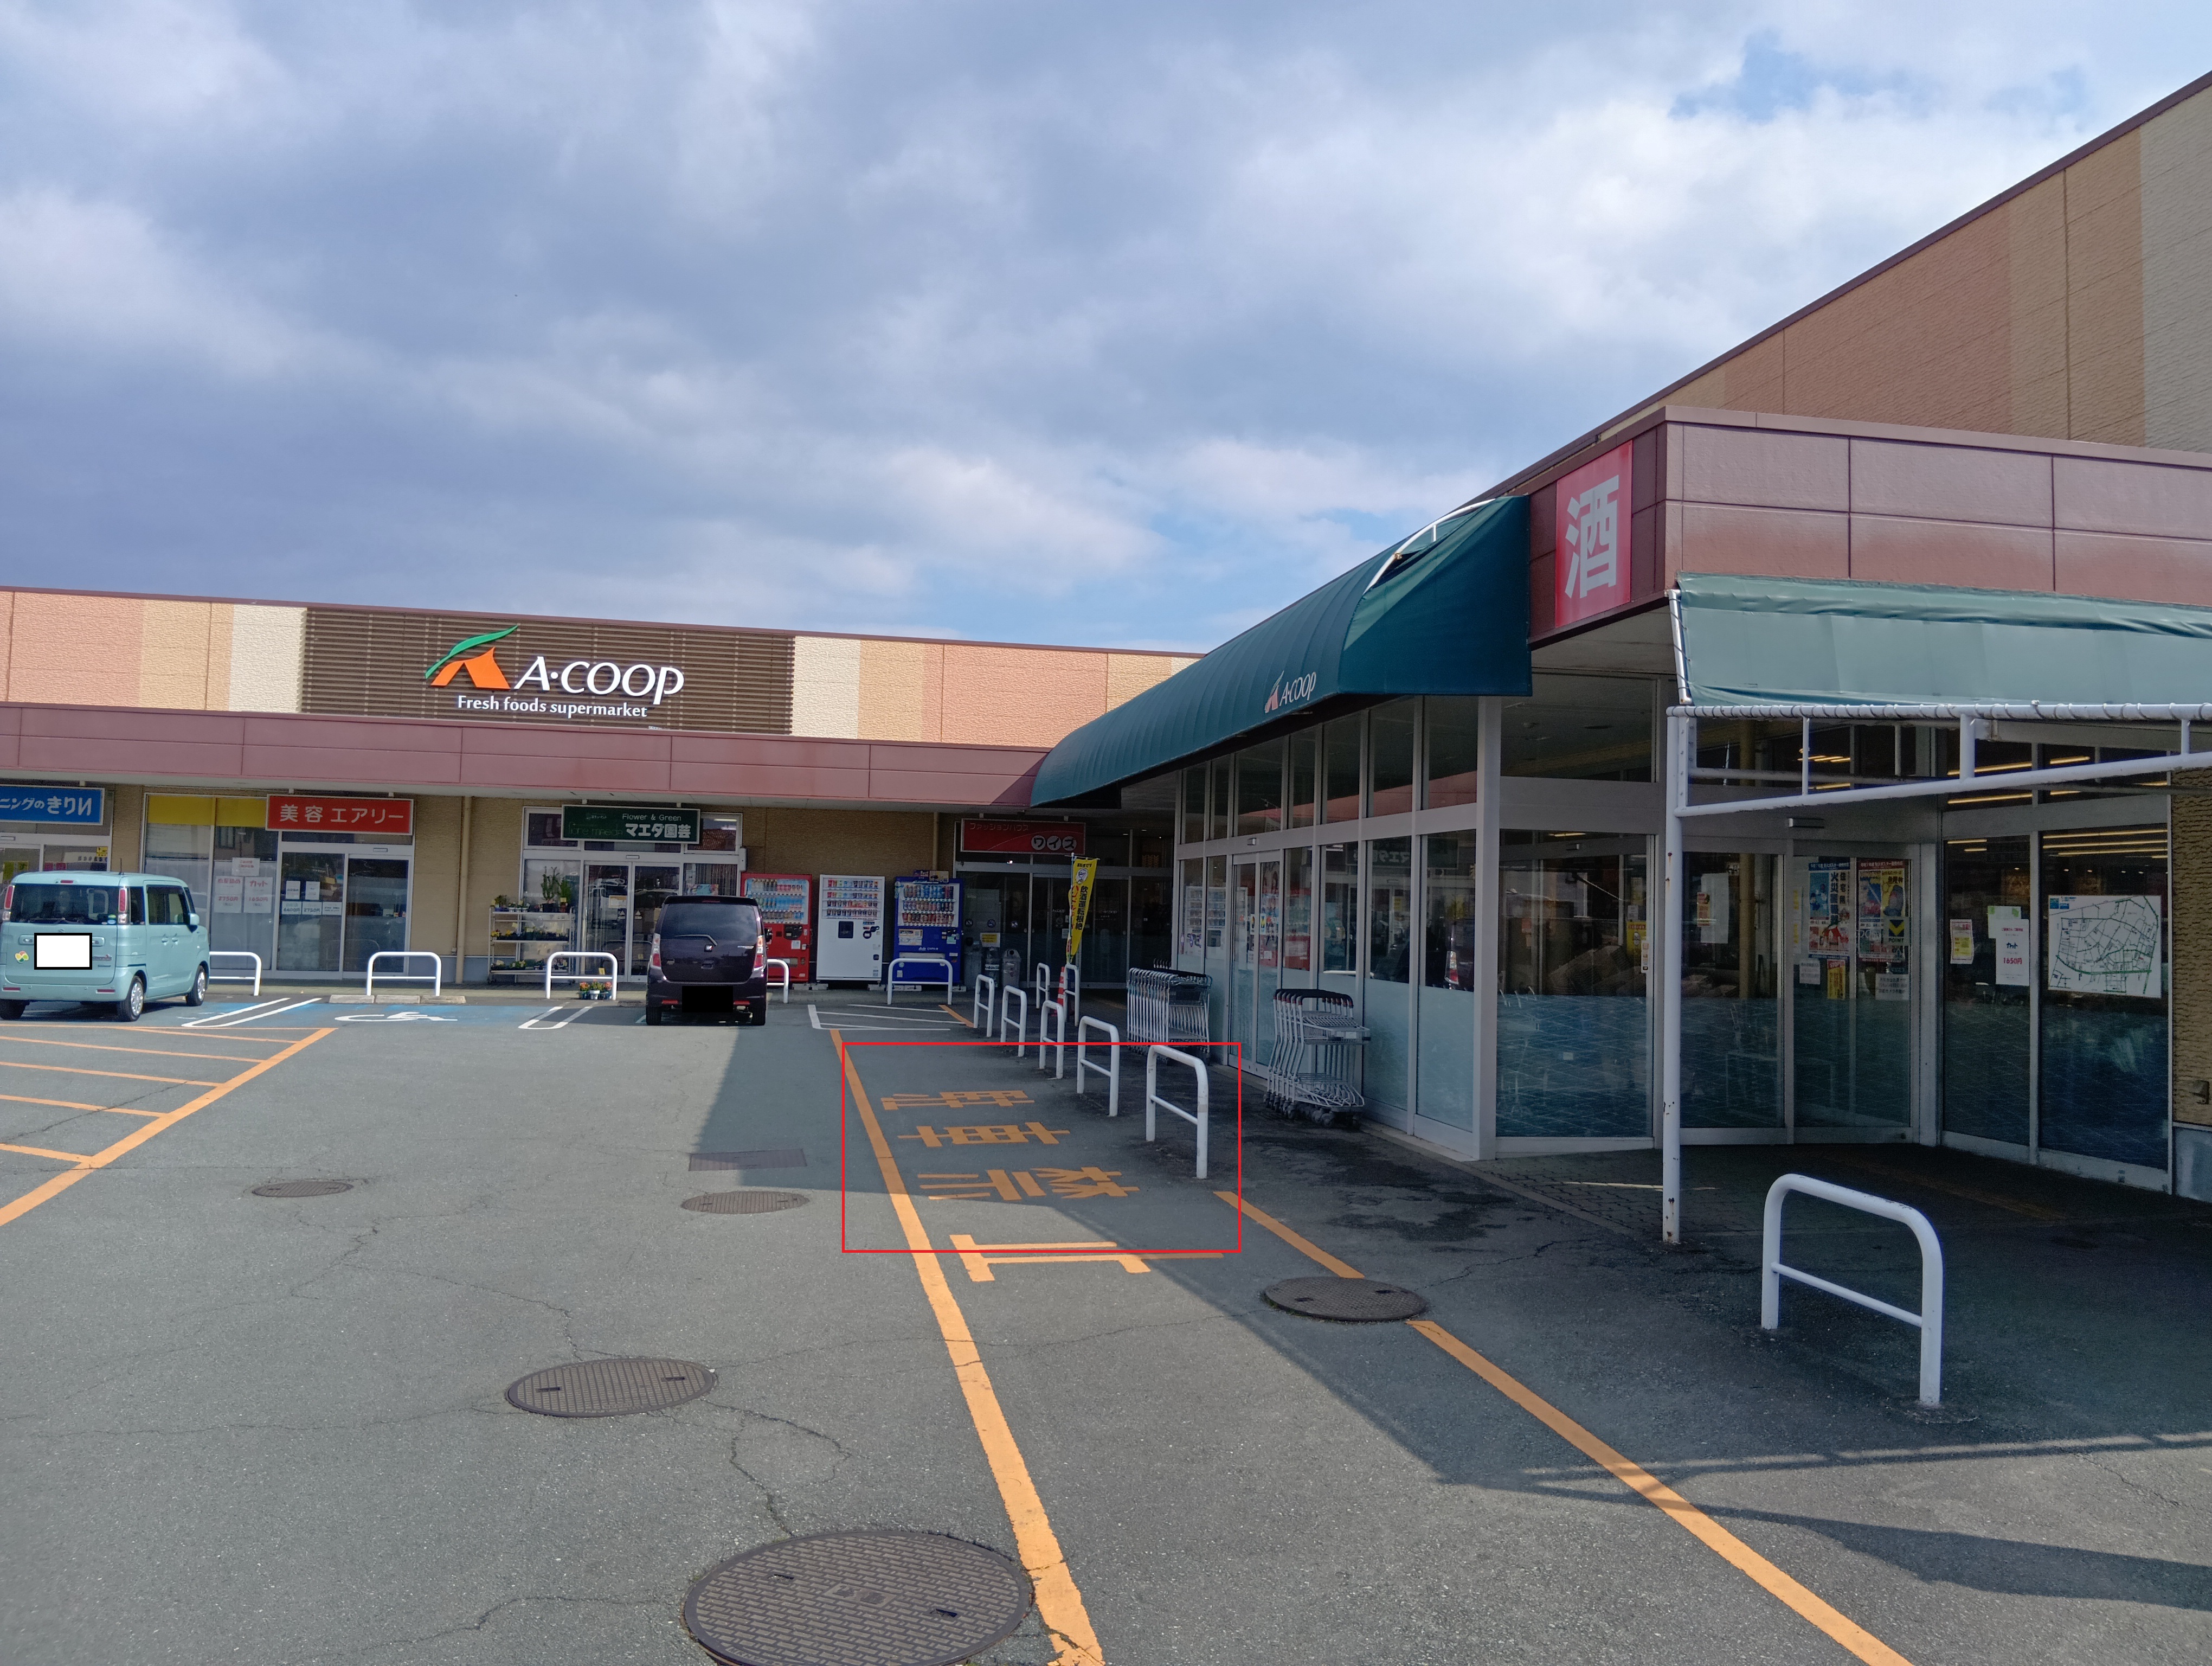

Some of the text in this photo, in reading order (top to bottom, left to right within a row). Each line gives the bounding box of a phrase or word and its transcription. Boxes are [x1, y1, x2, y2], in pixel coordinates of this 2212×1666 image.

[1565, 475, 1619, 599] 酒
[458, 695, 647, 719] Fresh foods supermarket
[280, 804, 403, 824] 美容 エアリー
[625, 823, 691, 838] マエダ園芸
[970, 823, 1029, 831] ファッションハウス
[1033, 837, 1076, 849] ワイズ
[880, 1090, 1224, 1281] 駐車禁止
